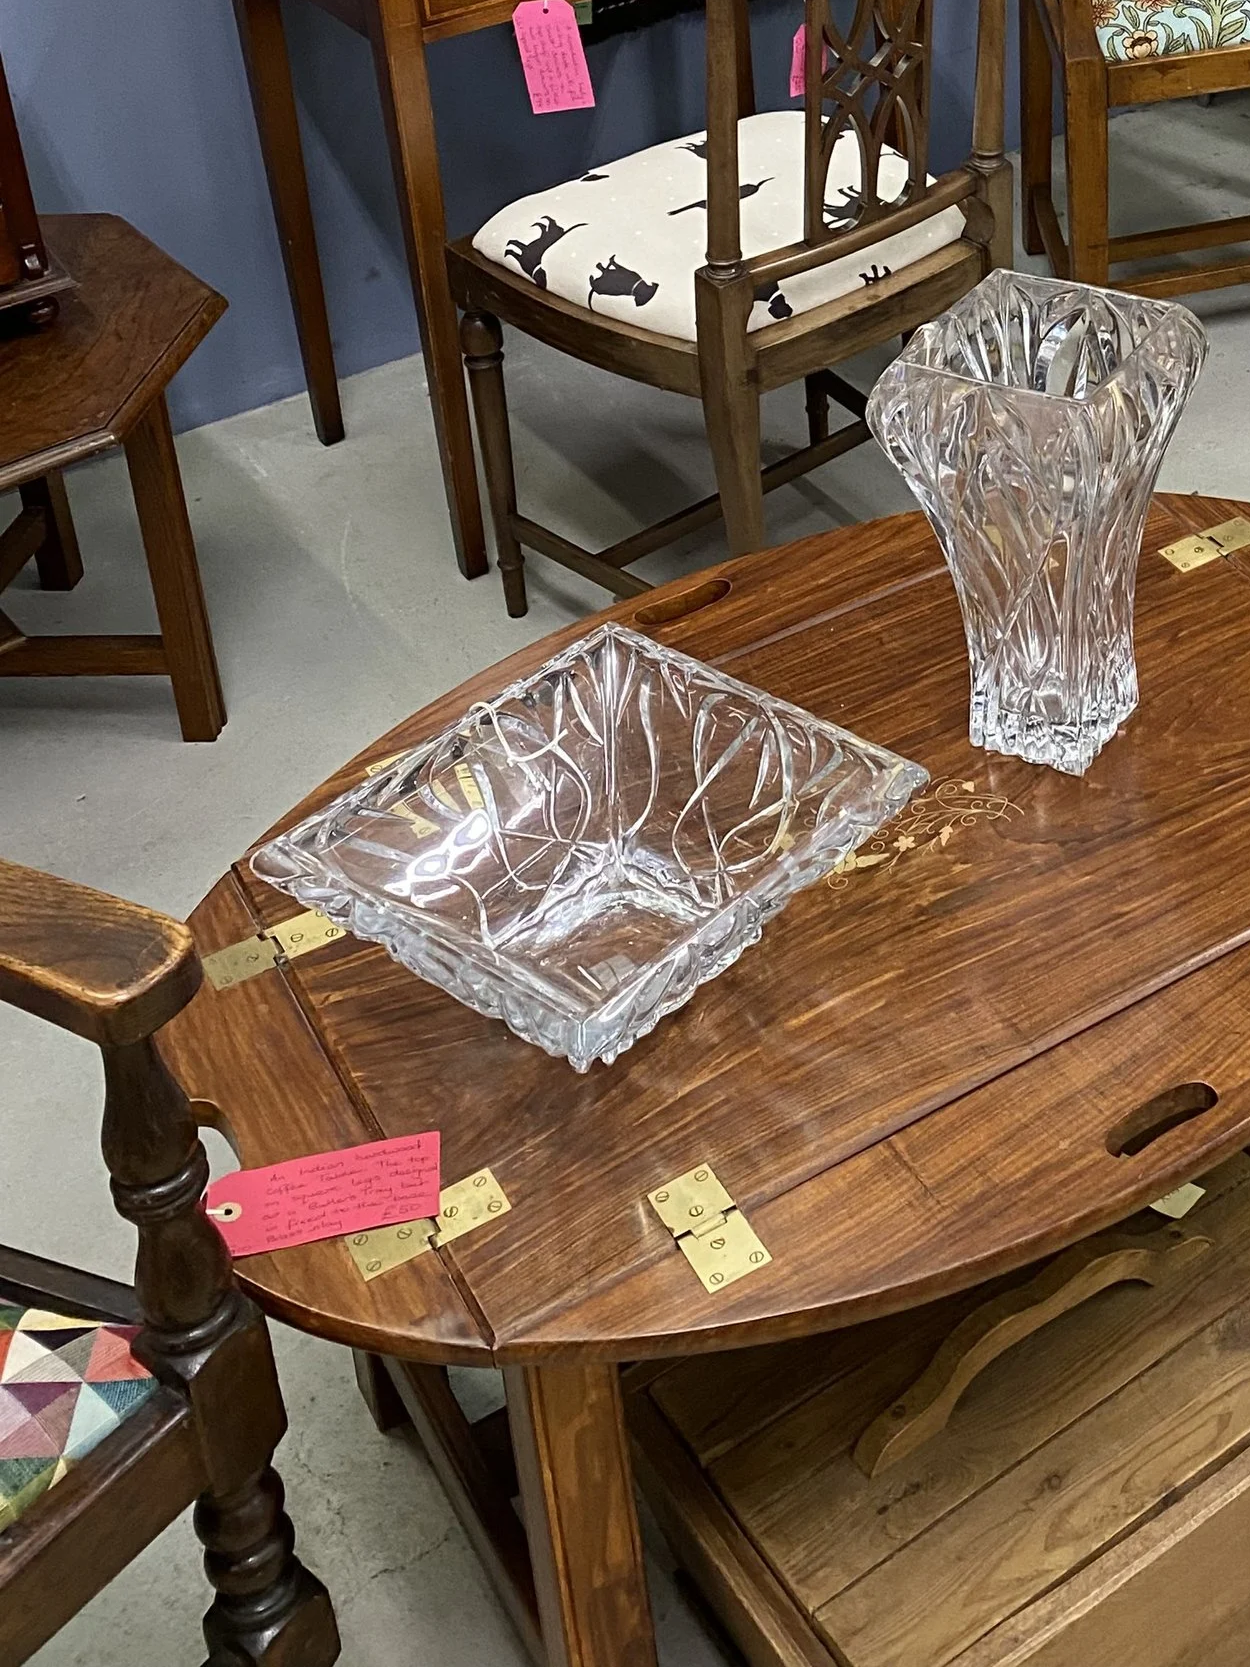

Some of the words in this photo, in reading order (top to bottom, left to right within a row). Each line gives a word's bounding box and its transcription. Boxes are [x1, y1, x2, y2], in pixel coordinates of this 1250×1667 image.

[266, 1183, 306, 1195] coffee
[374, 1159, 402, 1169] The
[268, 1172, 286, 1183] An
[299, 1161, 344, 1175] Indian
[354, 1139, 421, 1160] hardwood
[381, 1203, 421, 1220] £50
